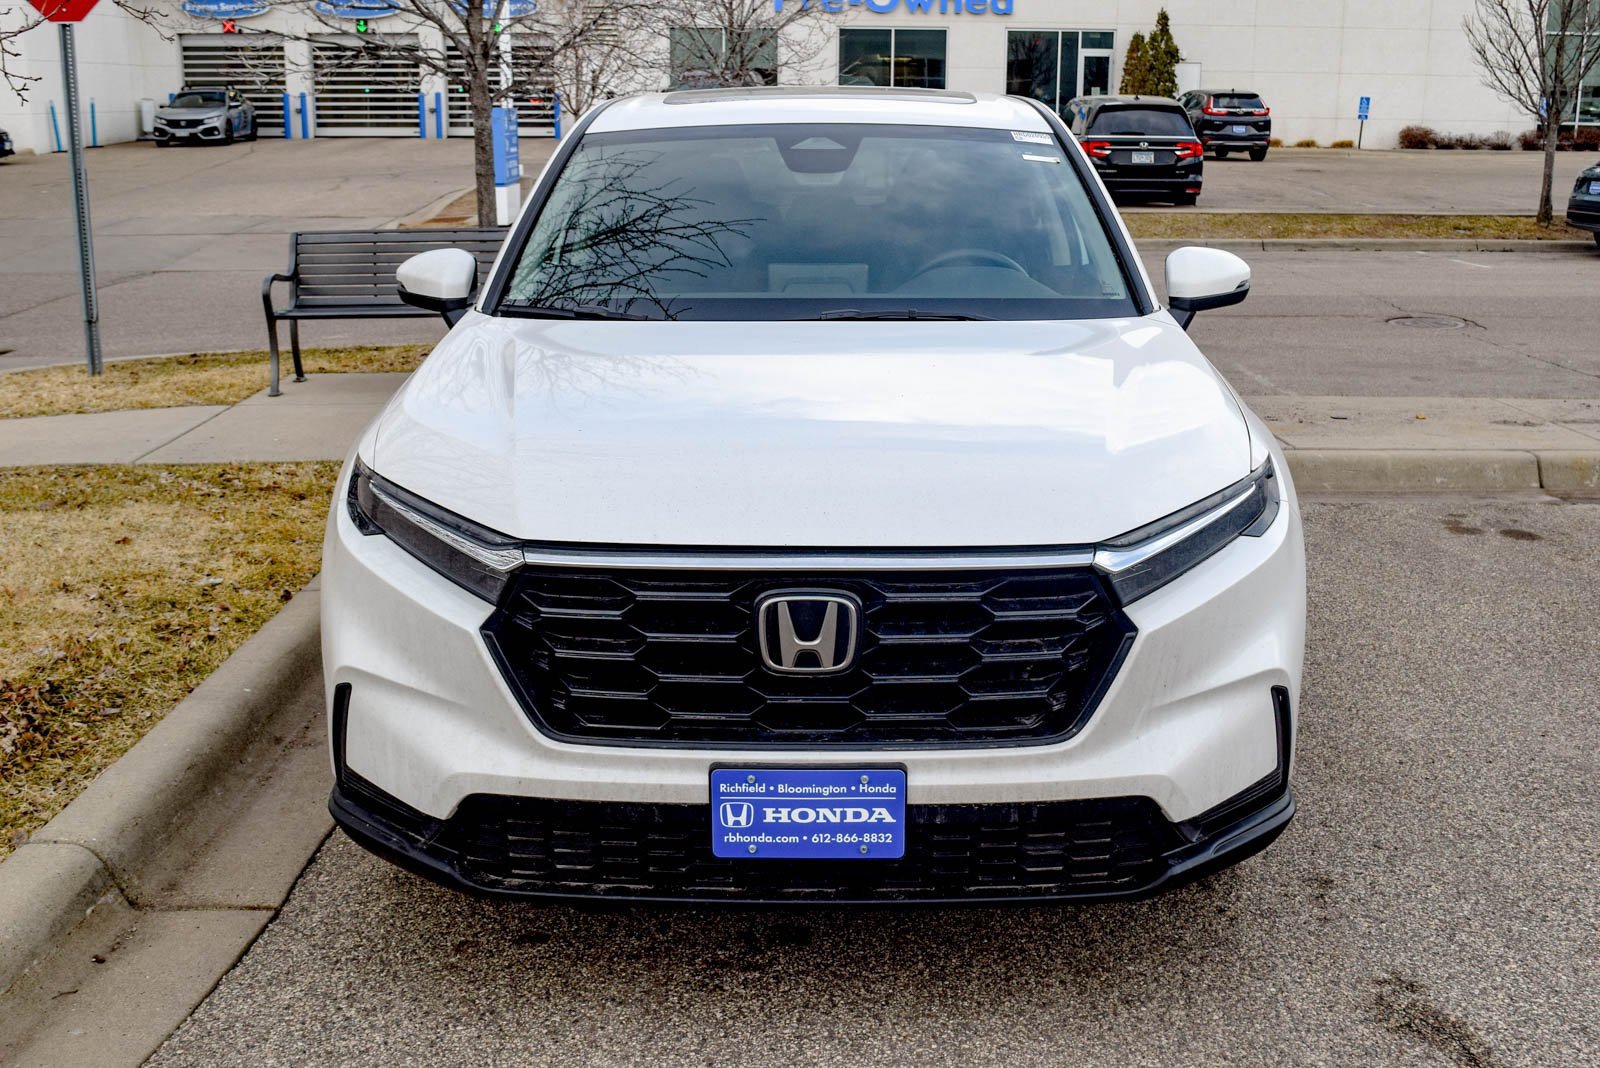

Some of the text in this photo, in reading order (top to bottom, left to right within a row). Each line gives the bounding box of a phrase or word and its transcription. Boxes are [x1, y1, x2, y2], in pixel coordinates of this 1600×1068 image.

[774, 0, 1013, 15] e-wne
[719, 783, 897, 796] Richfield Bloomington Honda
[762, 807, 897, 824] HONDA
[724, 832, 893, 844] rbhonda.com 612-866-8832
